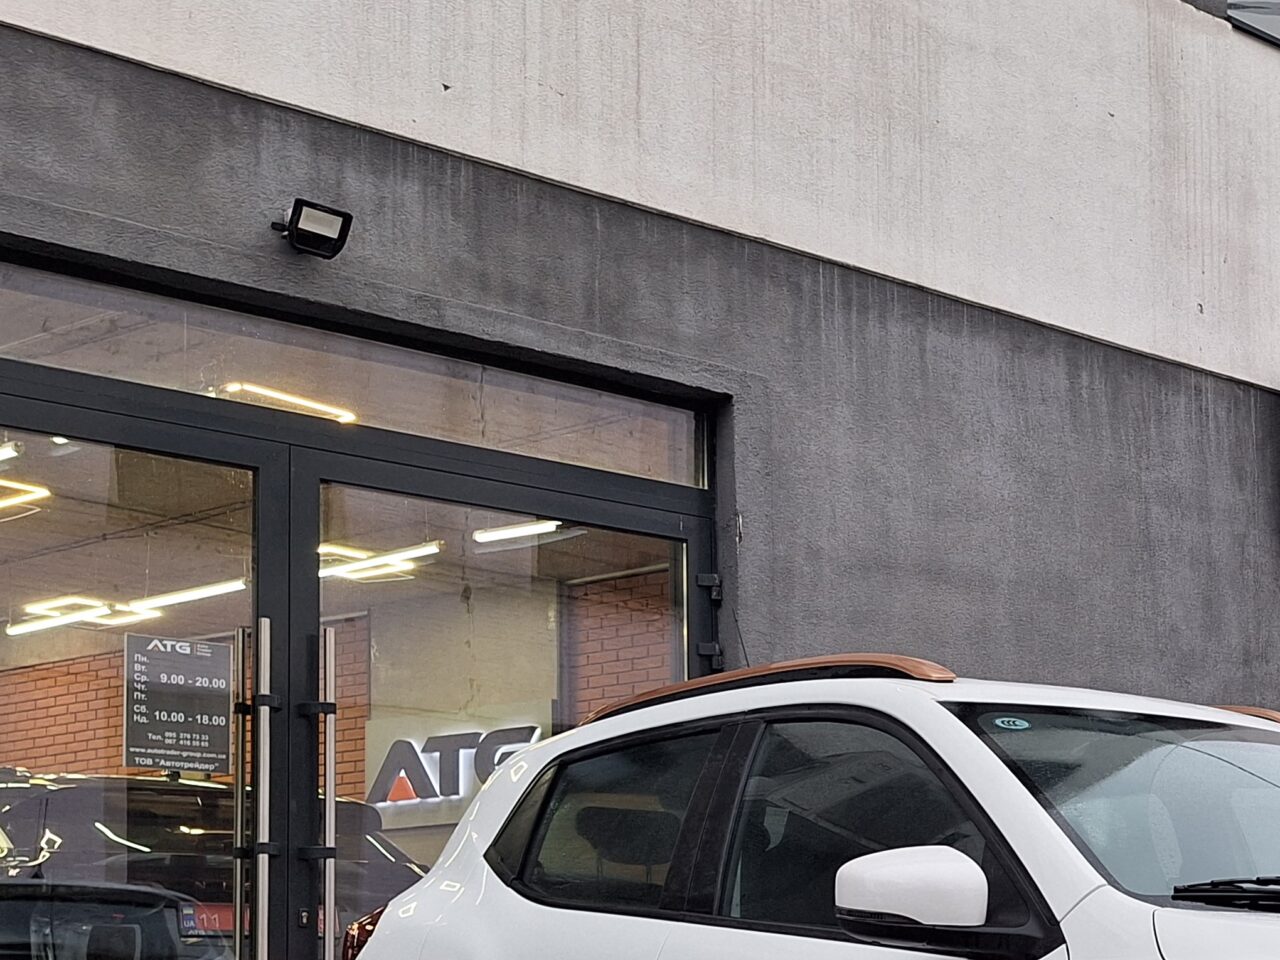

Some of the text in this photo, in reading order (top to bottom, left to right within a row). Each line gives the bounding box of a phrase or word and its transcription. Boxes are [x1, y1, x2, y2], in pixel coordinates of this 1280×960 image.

[146, 639, 191, 655] ATG
[134, 653, 149, 663] Пн.
[134, 663, 147, 672] Вт.
[134, 673, 149, 682] Ср.
[160, 673, 185, 685] 9.00
[195, 677, 226, 689] 20.00
[134, 682, 147, 691] Чт.
[134, 692, 147, 700] Пт.
[134, 704, 149, 713] Сб.
[134, 714, 149, 723] Нд.
[154, 710, 185, 722] 10.00
[195, 714, 226, 726] 18.00
[147, 733, 164, 741] Тел.
[134, 757, 219, 770] ТОВ "Автотрейдер"
[184, 920, 195, 928] UA
